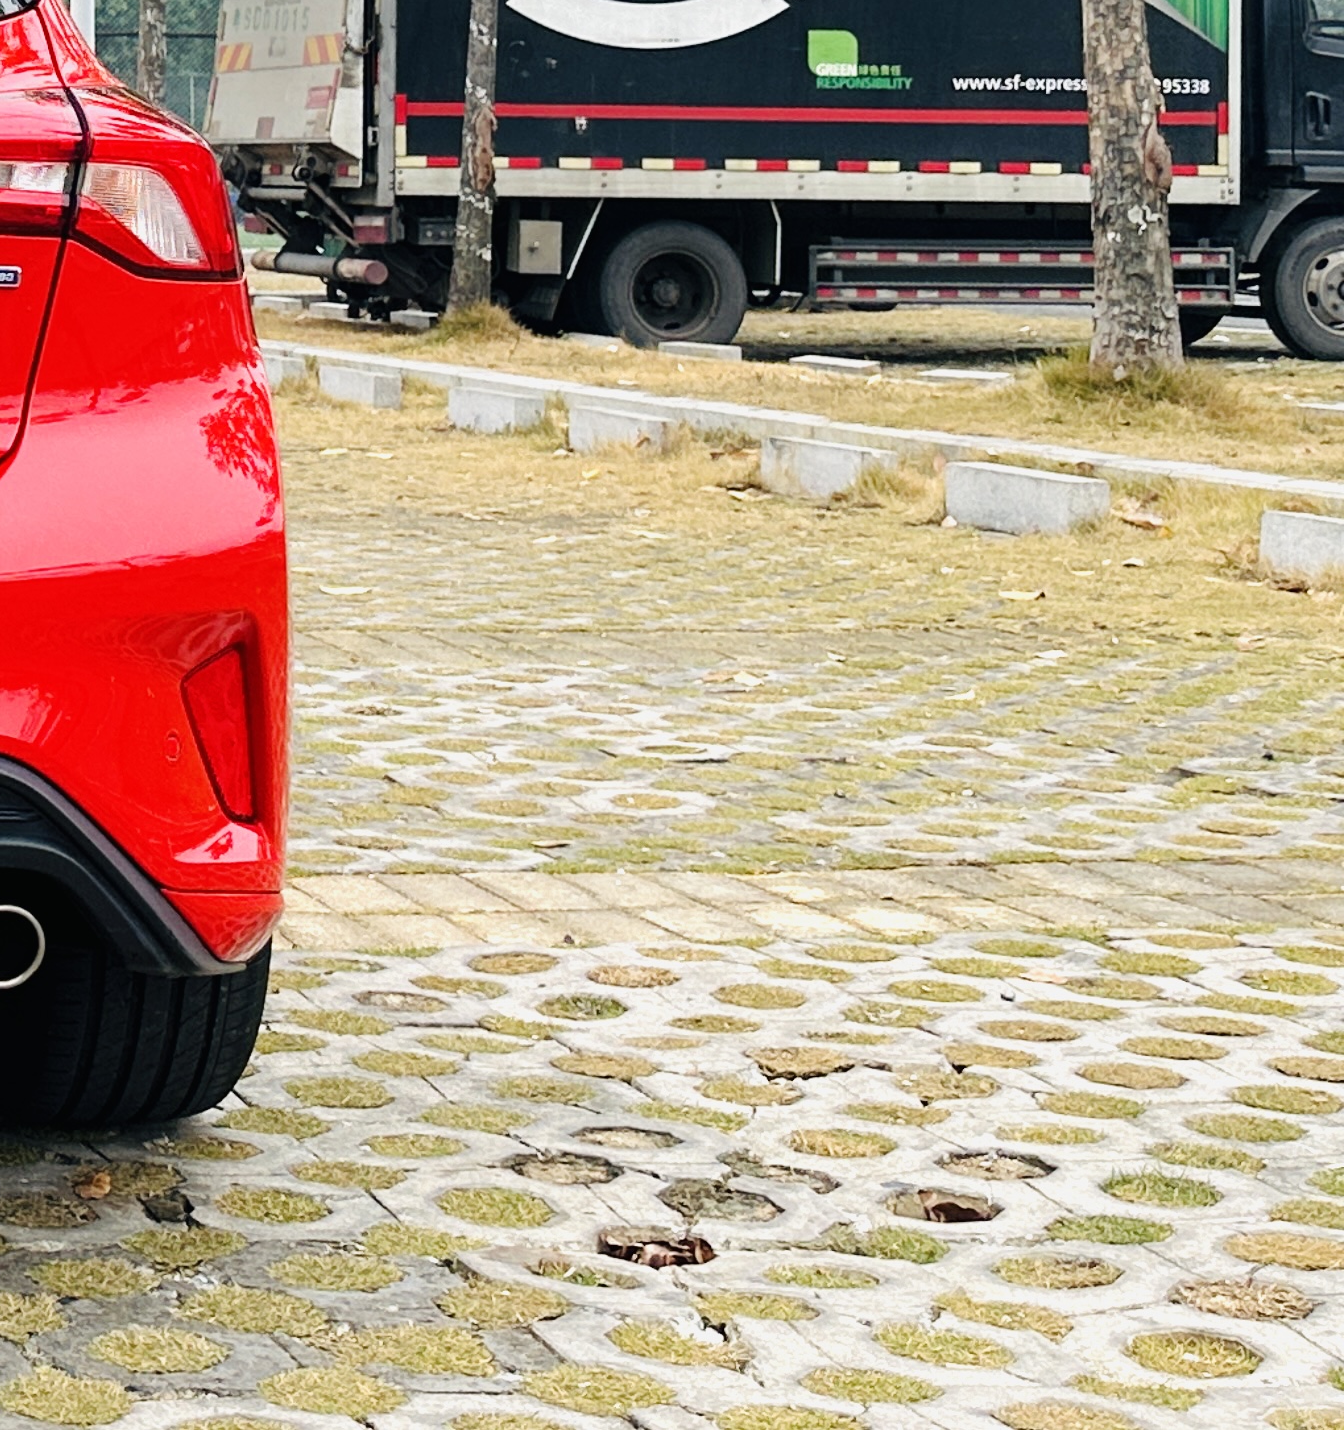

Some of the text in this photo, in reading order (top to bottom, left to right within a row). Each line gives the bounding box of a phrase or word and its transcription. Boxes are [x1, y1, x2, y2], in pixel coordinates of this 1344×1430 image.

[815, 63, 858, 77] GREEN
[952, 74, 1211, 95] www.sf-express 95338
